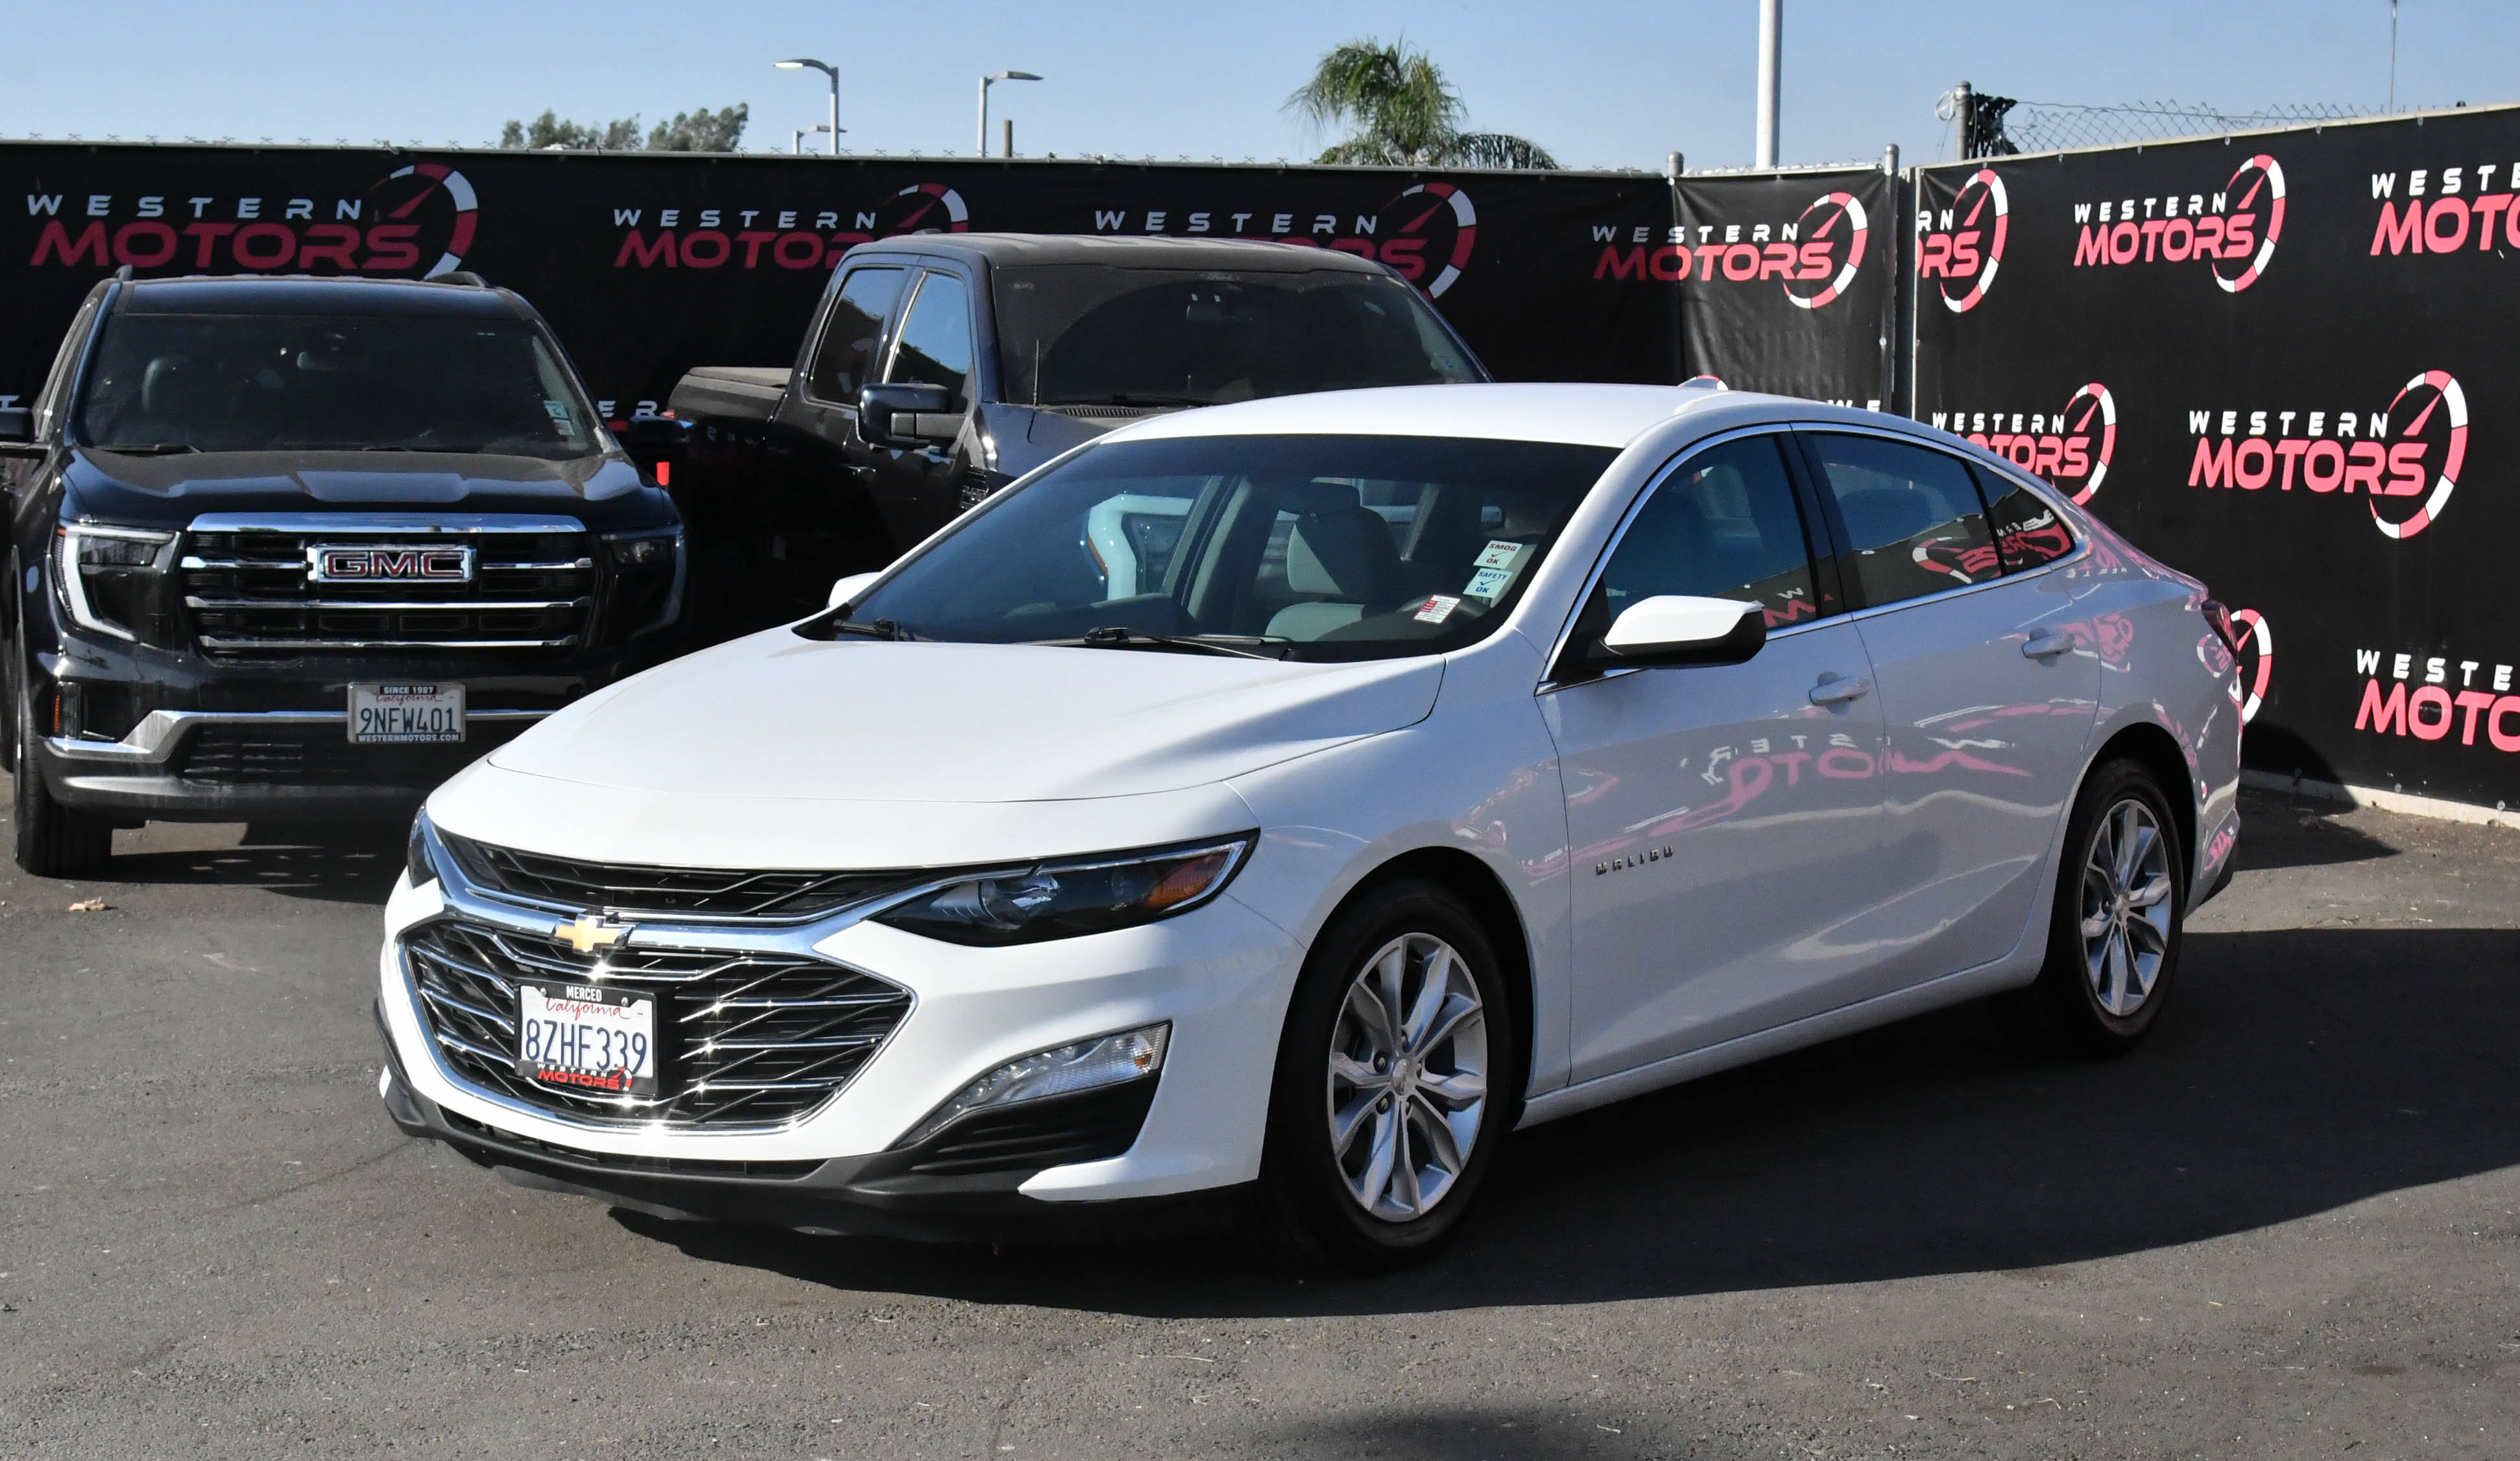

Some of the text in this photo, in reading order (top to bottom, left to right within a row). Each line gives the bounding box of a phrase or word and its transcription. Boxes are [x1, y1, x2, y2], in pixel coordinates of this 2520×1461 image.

[28, 194, 362, 219] WESTERN
[2074, 192, 2226, 224] WESTERN
[613, 209, 876, 230] WESTERN
[1095, 211, 1378, 235] WESTERN
[30, 220, 421, 270] MOTORS
[1592, 223, 1799, 243] WESTERN
[2074, 213, 2256, 267] MOTORS
[1592, 241, 1834, 281] MOTORS
[1932, 412, 2065, 434] WESTERN
[2189, 410, 2389, 439] WESTERN
[2187, 436, 2429, 497] MOTORS
[324, 551, 464, 577] GMC
[1478, 571, 1508, 580] SAFETY
[375, 695, 444, 706] California
[413, 686, 434, 695] 1987
[360, 707, 457, 733] 9NFW401
[358, 733, 459, 742] WESTERNMOTORS.COM
[1596, 845, 1674, 875] MALIBU
[566, 985, 603, 1002] MERCED
[546, 997, 630, 1021] California
[525, 1018, 647, 1075] 8ZHF339
[538, 1069, 621, 1090] MOTORS
